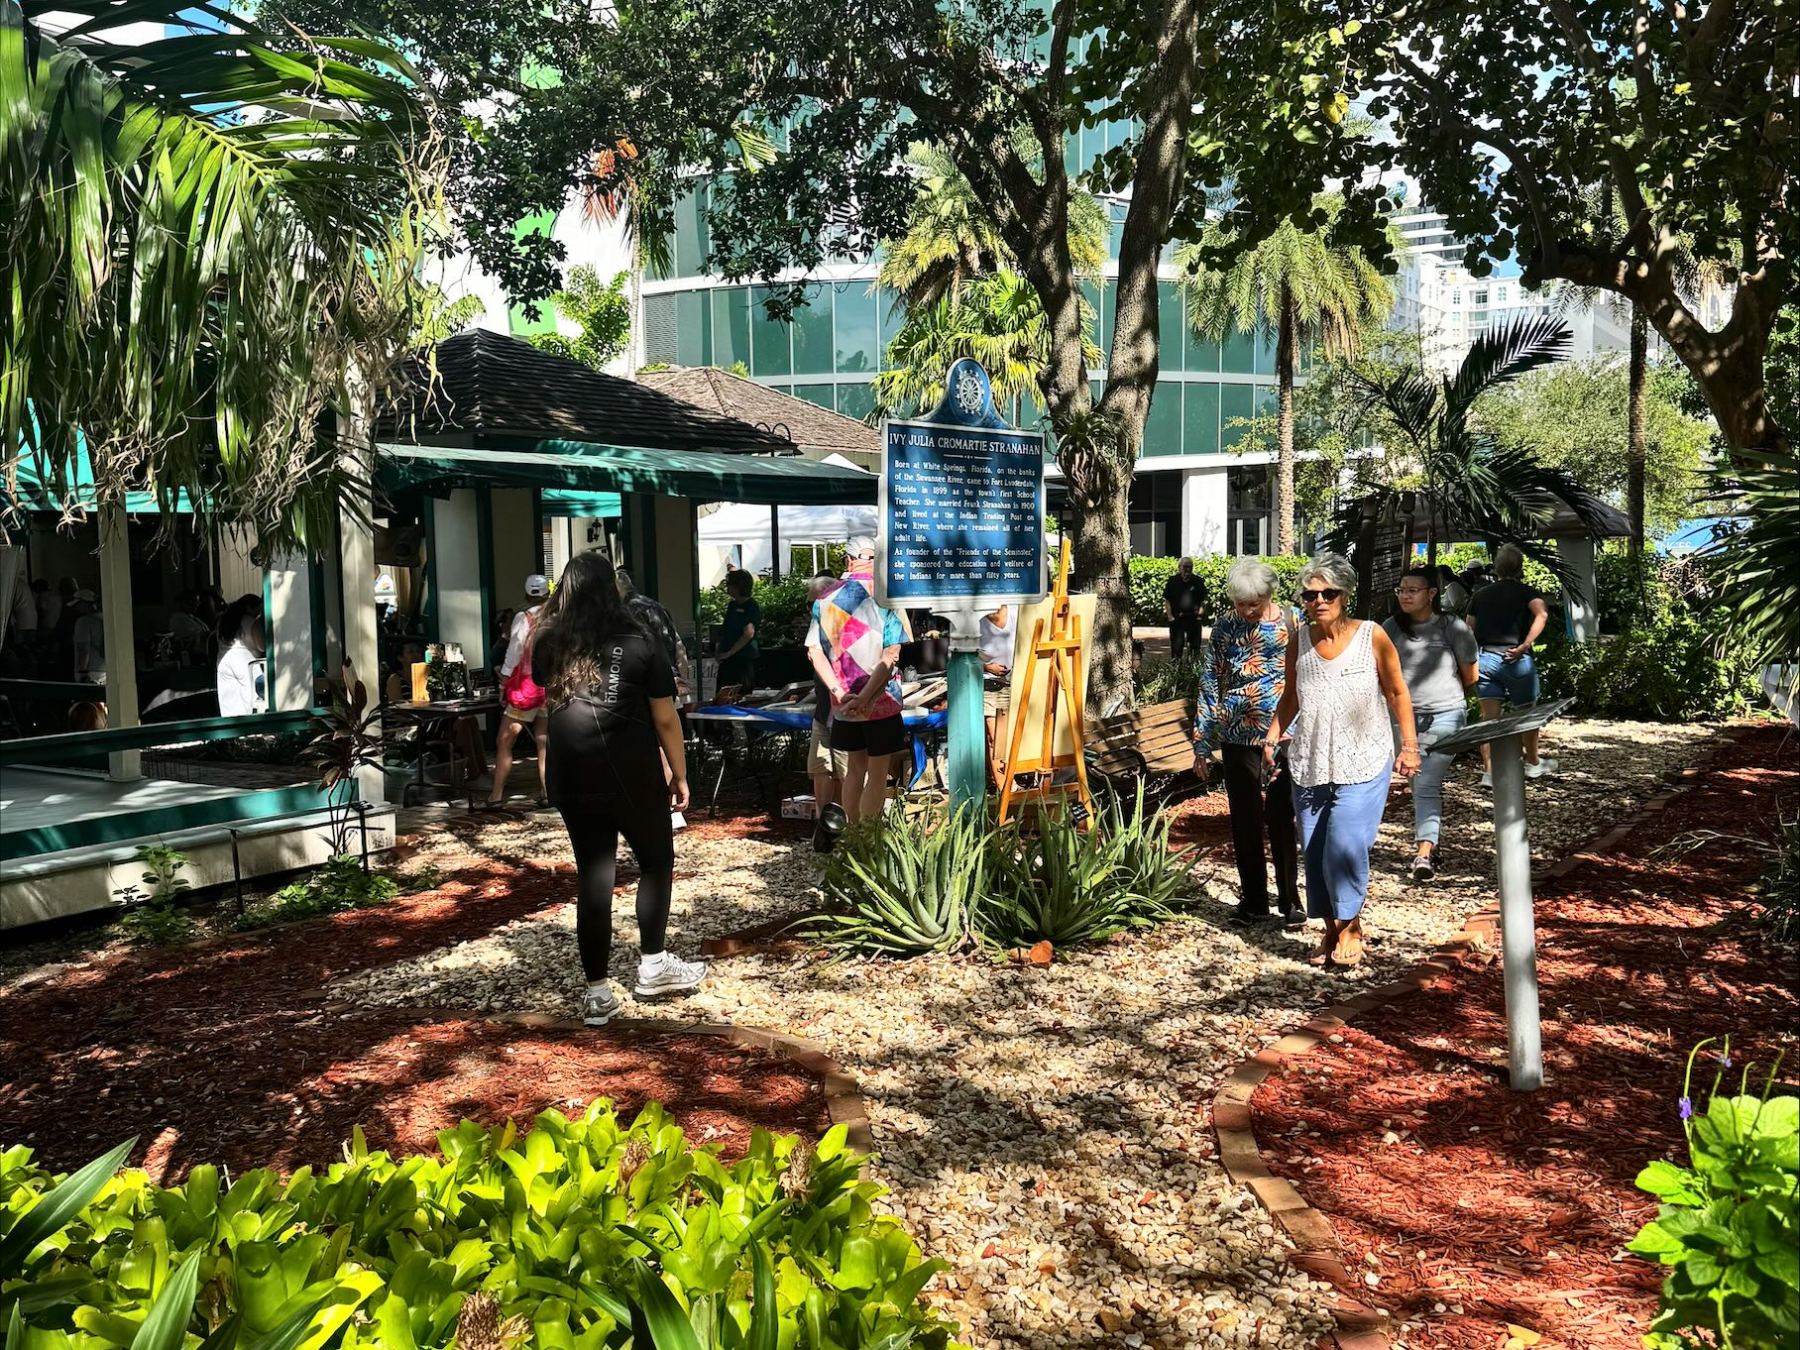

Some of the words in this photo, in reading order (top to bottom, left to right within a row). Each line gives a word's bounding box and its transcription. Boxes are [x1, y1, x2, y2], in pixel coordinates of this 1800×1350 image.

[890, 433, 906, 445] IVY
[909, 435, 935, 447] JULIA
[938, 438, 987, 451] CROMARTIE
[989, 442, 1040, 455] STRANAHAN
[895, 460, 909, 469] Born
[923, 462, 940, 470] White
[1019, 468, 1035, 476] banks
[991, 478, 1003, 486] Fort
[895, 485, 916, 493] Florida
[922, 486, 928, 494] in
[964, 488, 973, 496] the
[1000, 490, 1013, 498] first
[983, 501, 1011, 509] Stranahan
[1021, 502, 1034, 510] 1900
[960, 512, 977, 520] Indian
[984, 513, 1005, 521] Trading
[1010, 513, 1022, 521] Post
[1024, 525, 1034, 533] her
[894, 534, 911, 542] adult
[894, 560, 905, 568] she
[987, 572, 999, 580] fifty
[1004, 572, 1021, 580] years.
[607, 646, 624, 703] DIAMOND
